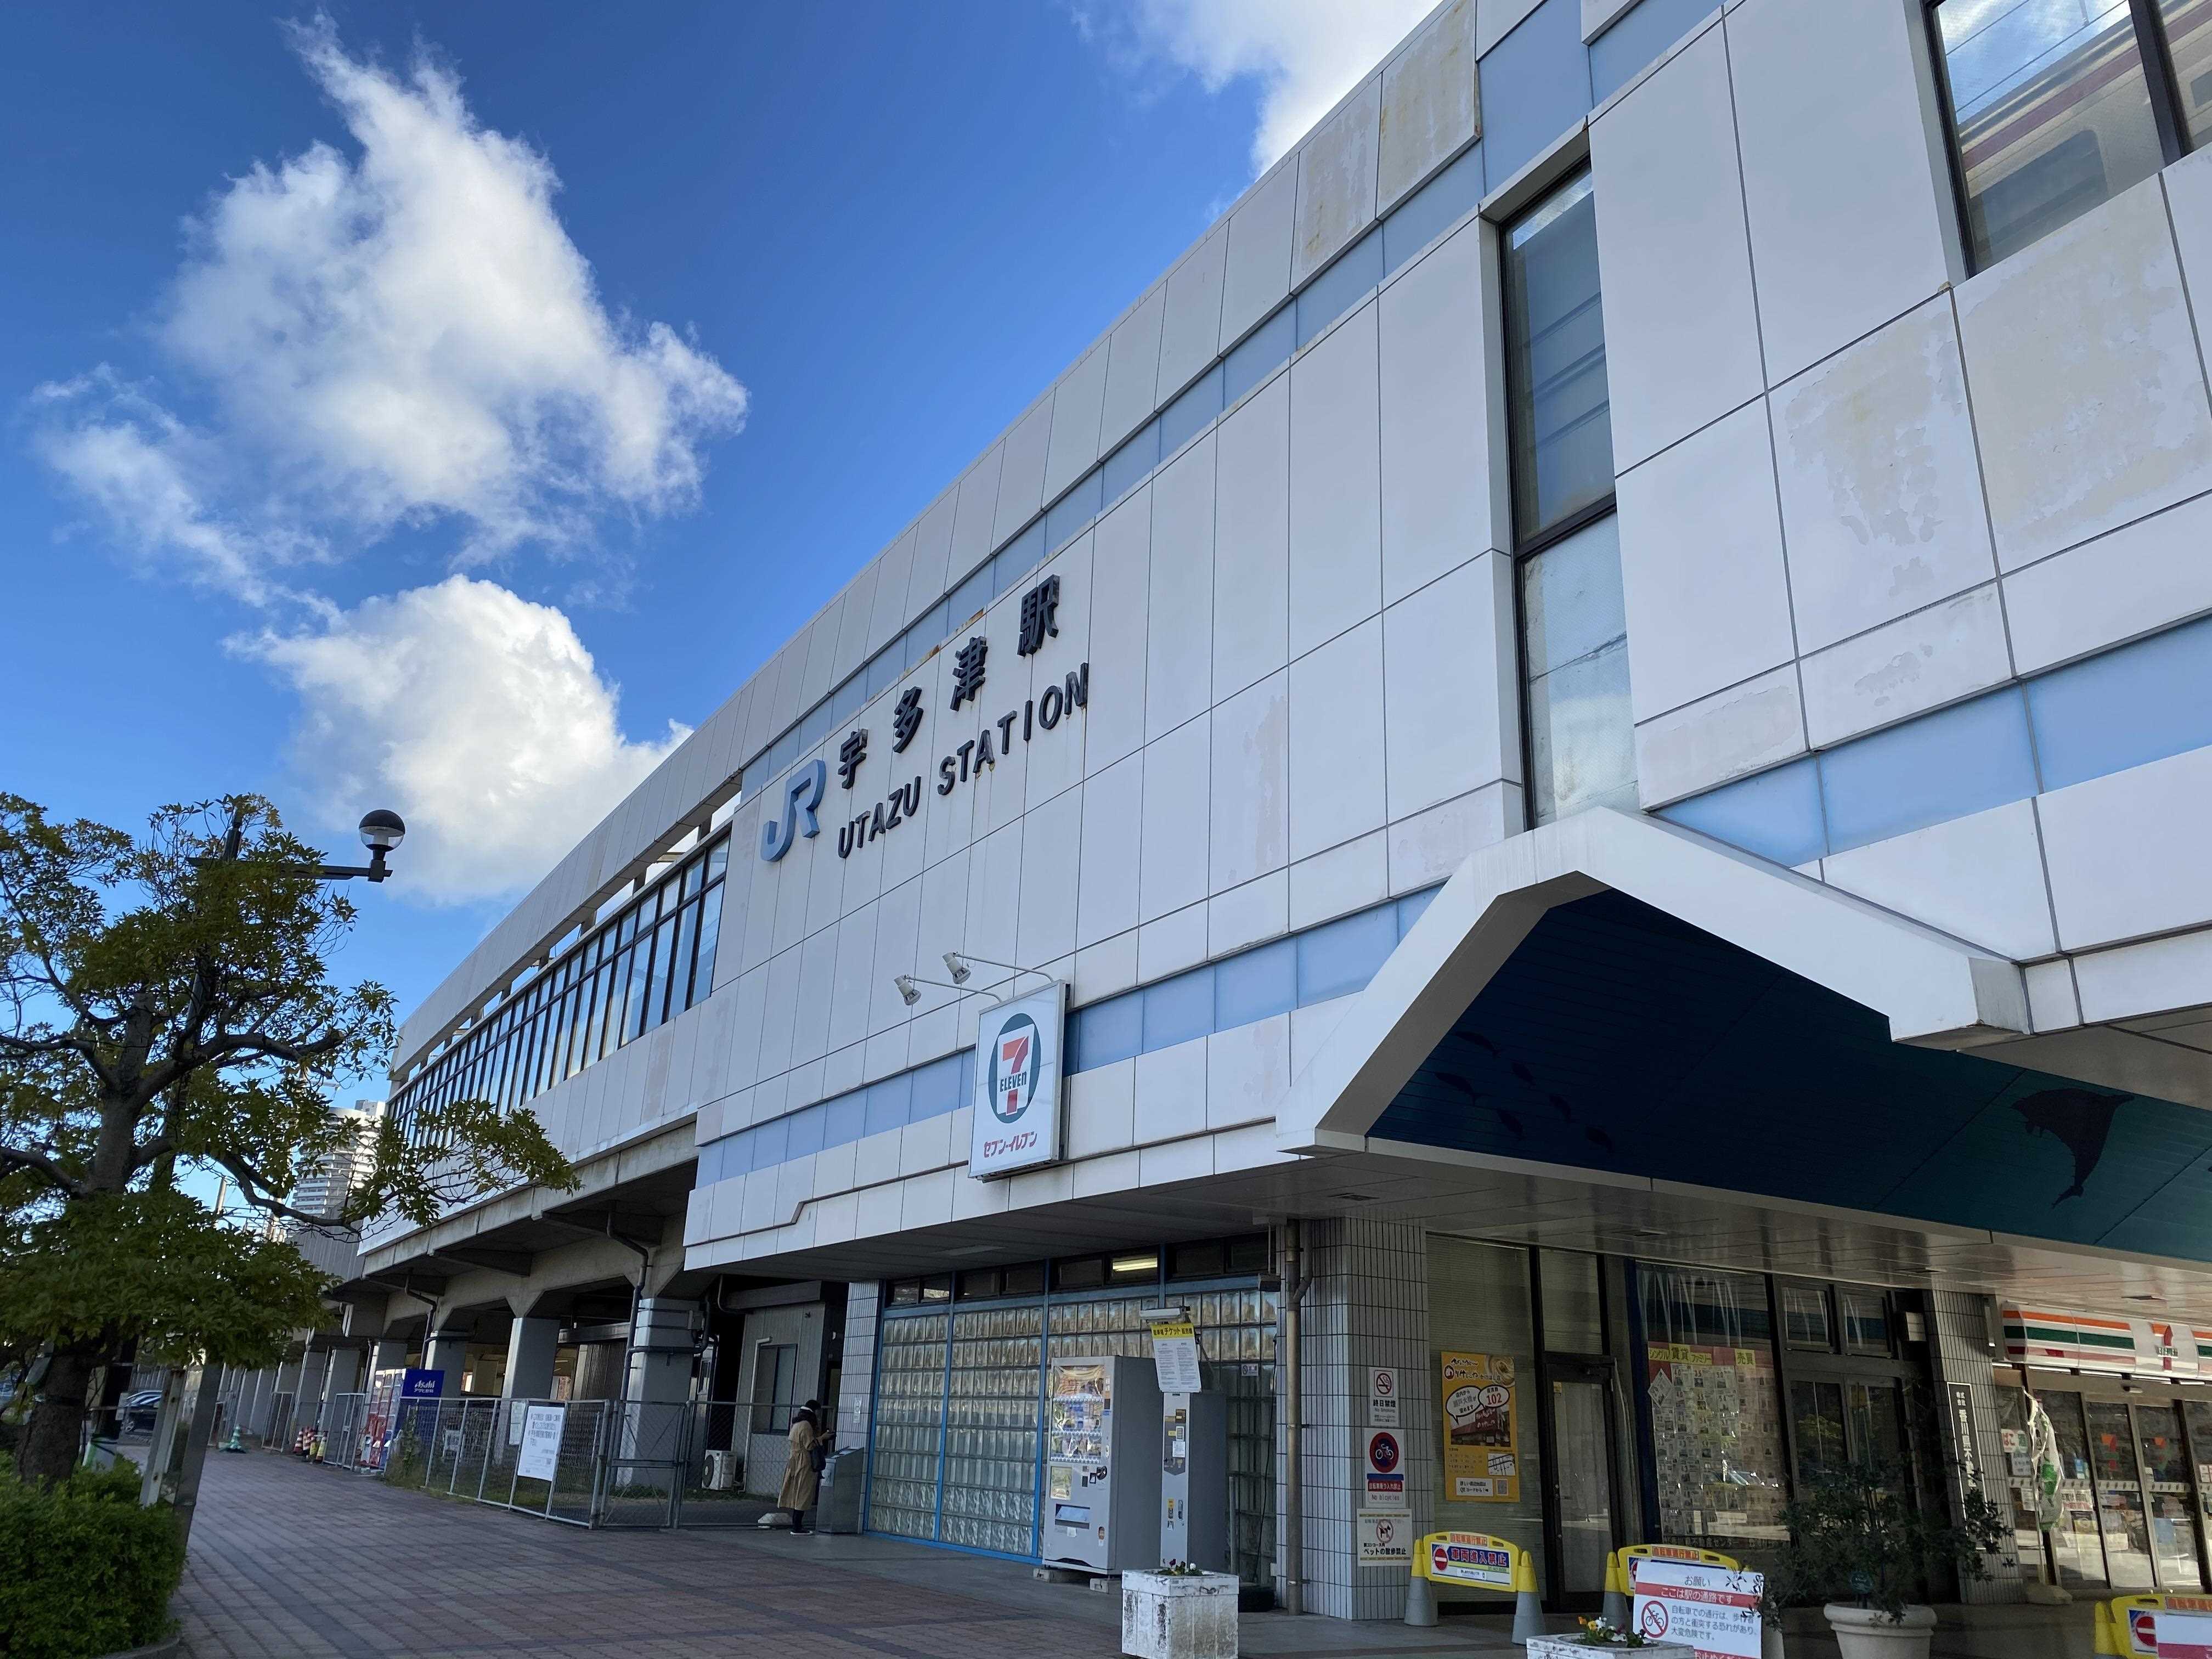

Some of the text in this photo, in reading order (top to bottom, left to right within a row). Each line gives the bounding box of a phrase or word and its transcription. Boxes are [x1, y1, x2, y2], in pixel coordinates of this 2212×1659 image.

[838, 574, 1060, 789] 宇多津駅
[838, 663, 1089, 859] UTAZU STATION
[760, 759, 827, 861] JR
[1373, 1399, 1396, 1407] 終日禁煙
[1486, 1393, 1503, 1405] 102
[1451, 1548, 1506, 1566] 車両進入禁止
[1685, 1576, 1711, 1587] お願い
[1661, 1587, 1734, 1604] ここは駅の通路です
[1671, 1627, 1715, 1641] 大変危険です。
